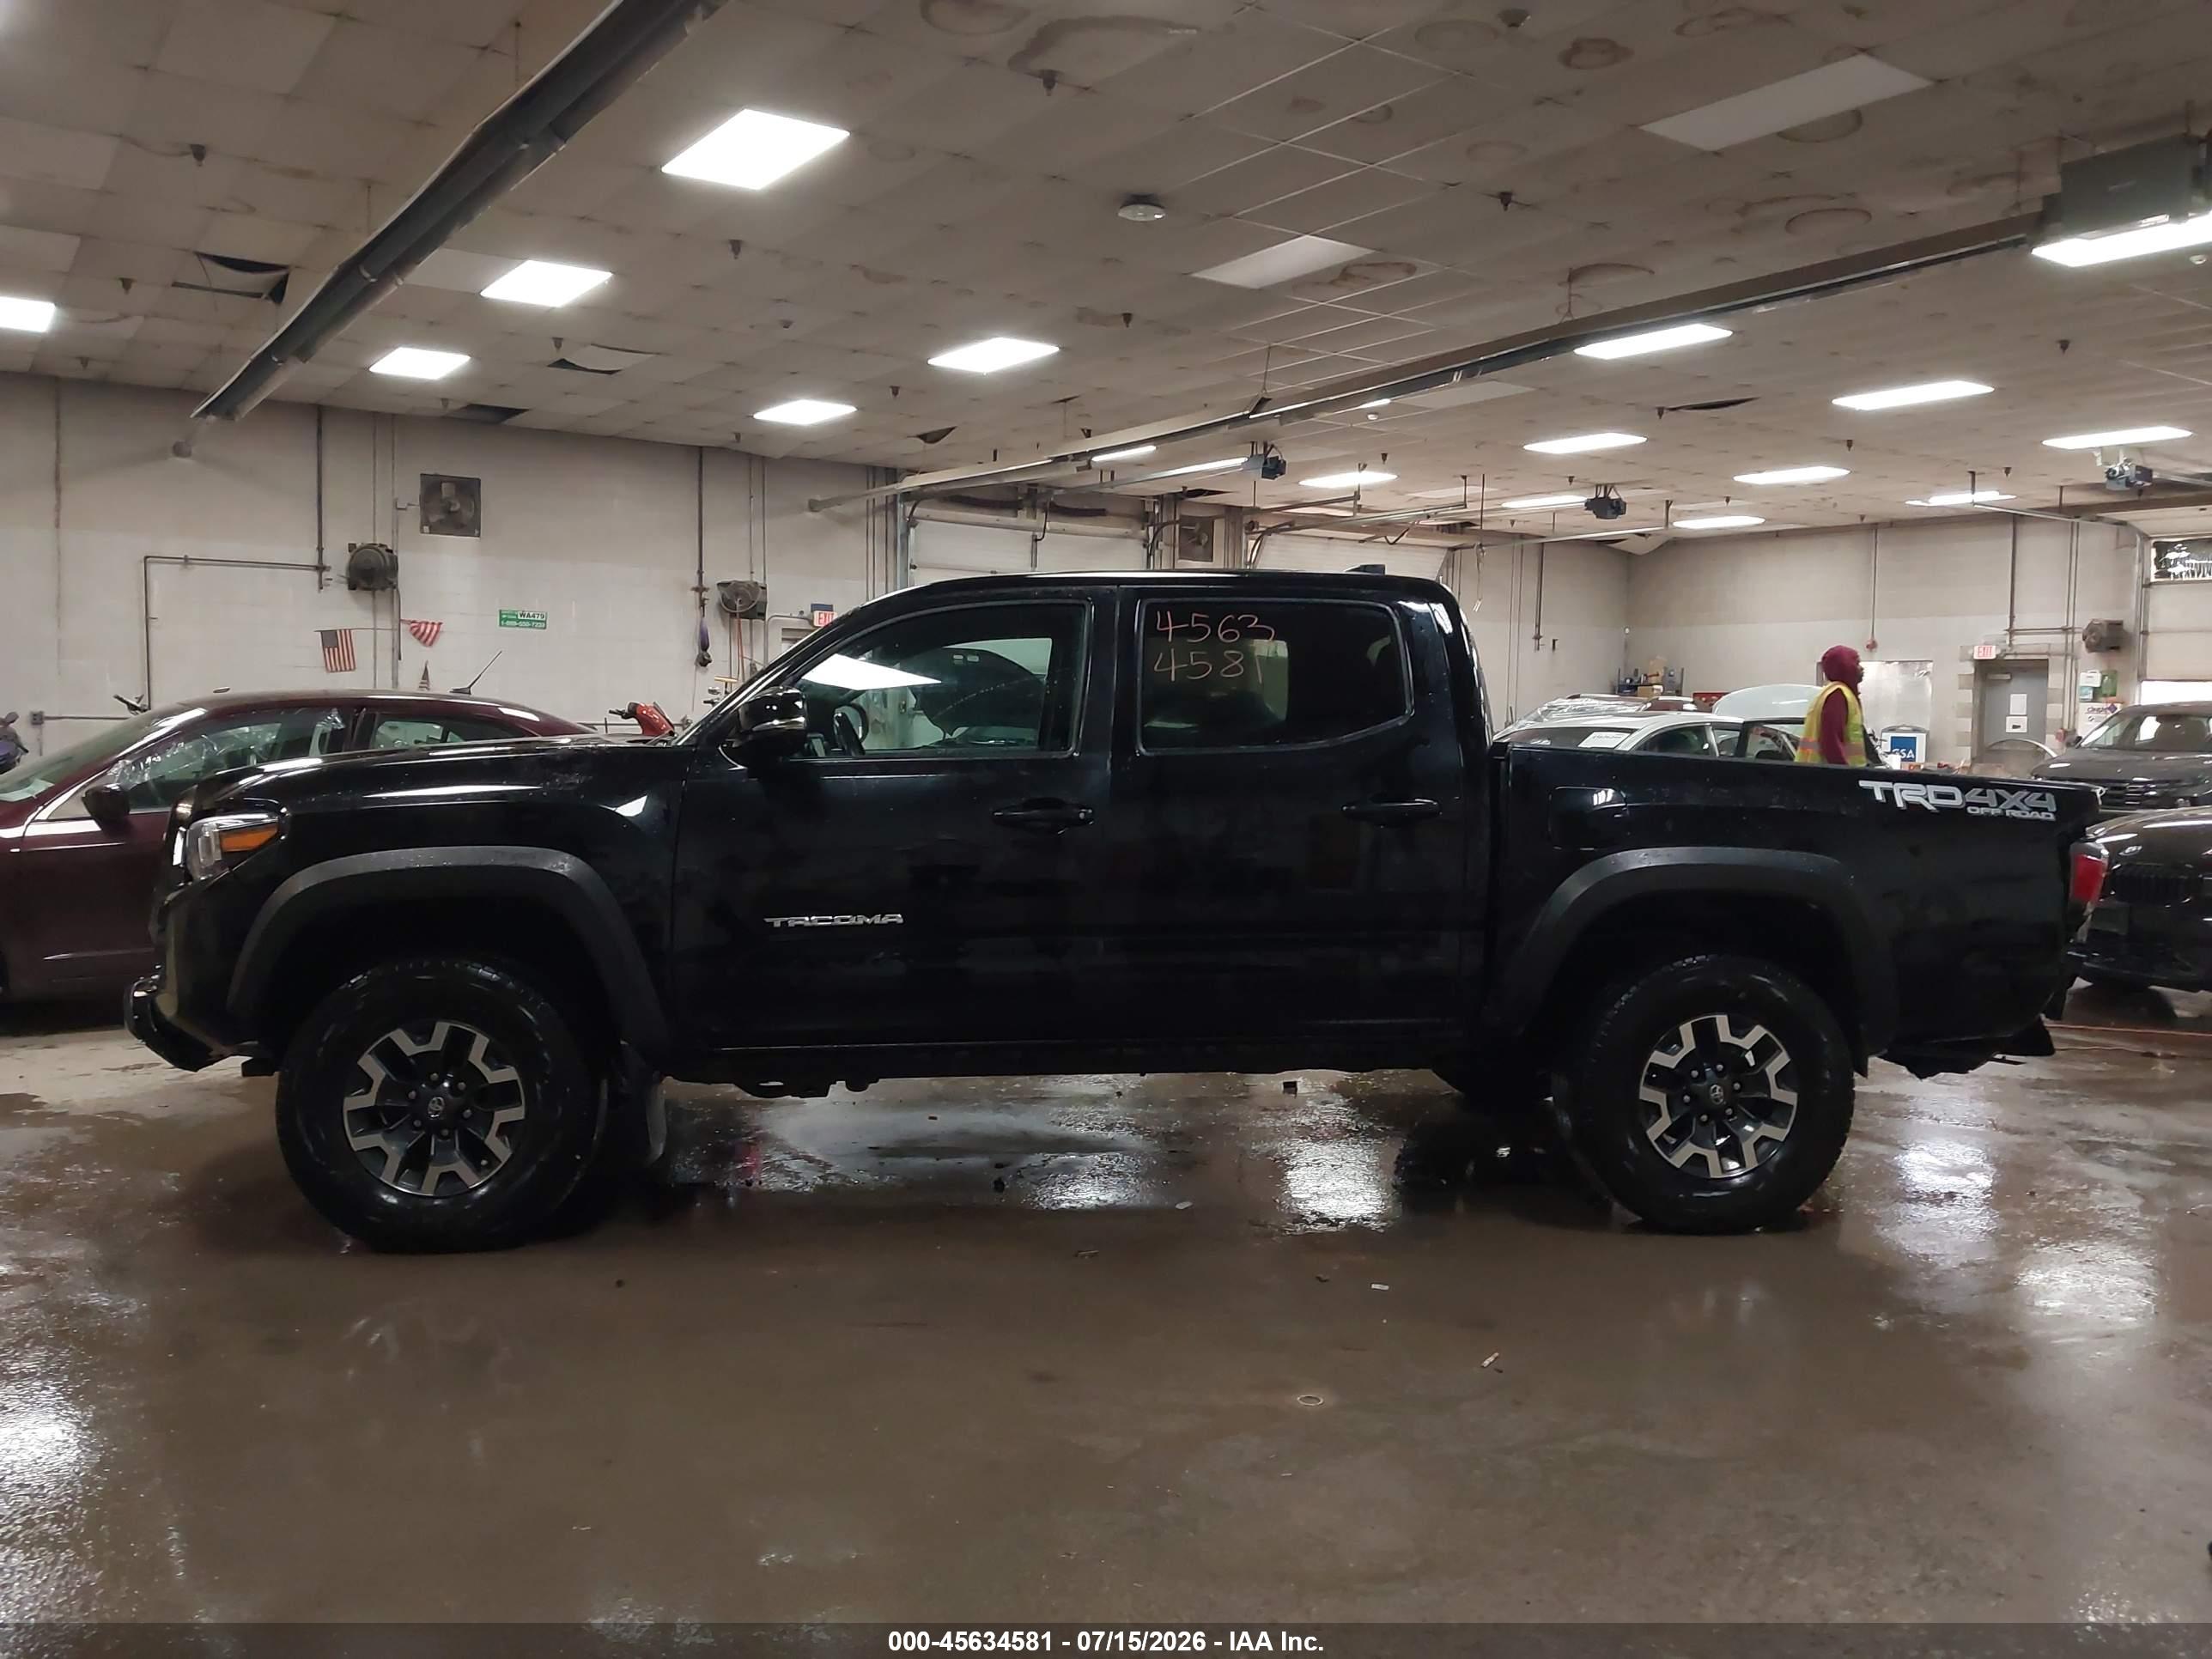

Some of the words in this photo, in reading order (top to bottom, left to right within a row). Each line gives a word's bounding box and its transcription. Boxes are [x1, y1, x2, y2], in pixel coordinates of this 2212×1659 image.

[1156, 611, 1275, 642] 4563
[1153, 648, 1263, 684] 4581
[1966, 805, 2002, 817] OFF
[2006, 809, 2056, 822] ROAD
[763, 914, 903, 927] TACOMA
